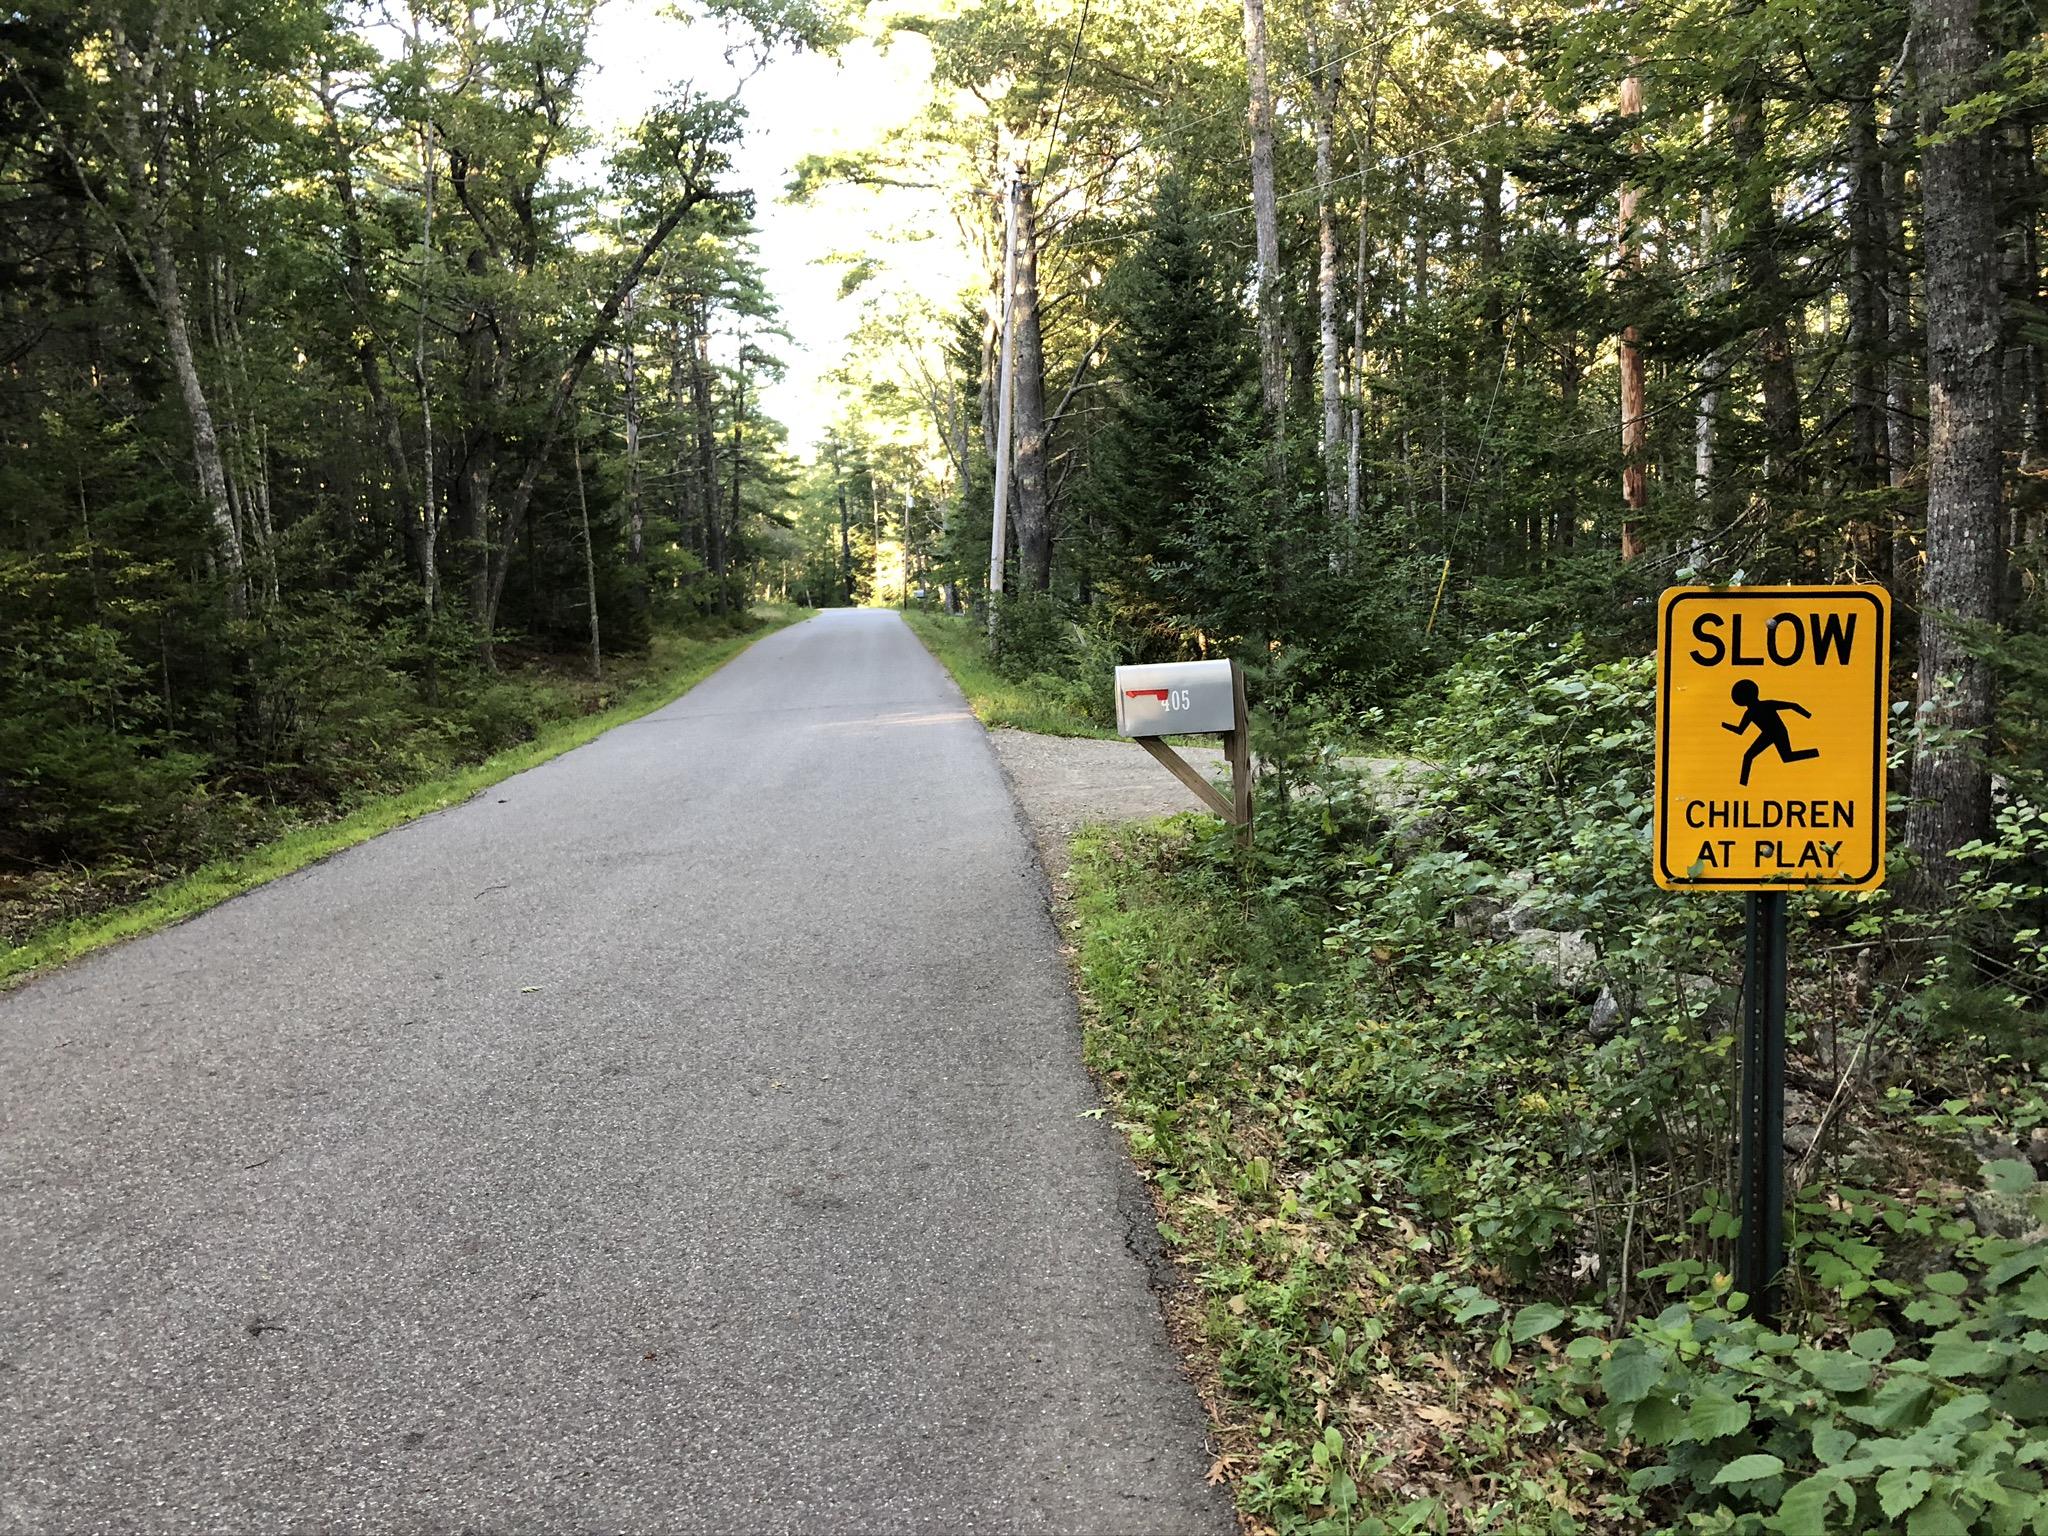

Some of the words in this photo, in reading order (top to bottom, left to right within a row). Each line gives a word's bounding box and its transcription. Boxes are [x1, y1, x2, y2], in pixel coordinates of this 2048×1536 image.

[1689, 612, 1857, 667] SLOW
[1685, 800, 1854, 829] CHILDREN
[1697, 840, 1736, 868] AT
[1754, 840, 1843, 868] PLAY
